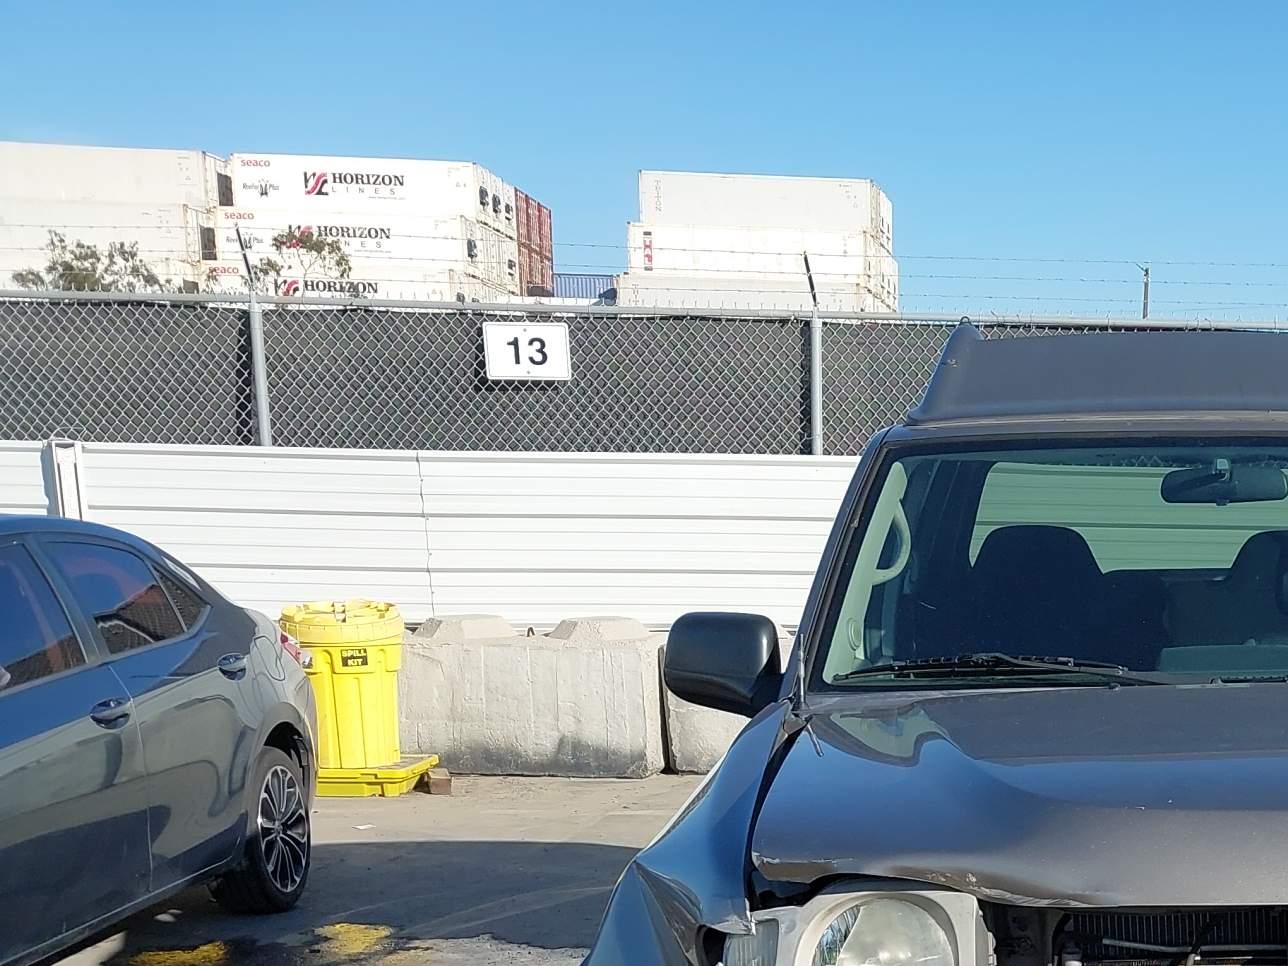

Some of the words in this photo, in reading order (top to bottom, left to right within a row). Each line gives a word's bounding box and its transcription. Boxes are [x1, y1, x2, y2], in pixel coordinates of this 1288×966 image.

[240, 158, 271, 168] seaco
[331, 172, 405, 187] HORIZON
[331, 186, 396, 196] LINES
[224, 212, 255, 220] seaco
[316, 225, 391, 240] HORIZON
[208, 264, 239, 274] seaco
[304, 279, 379, 294] HORIZON
[506, 336, 548, 366] 13
[342, 650, 367, 658] SPILL
[347, 658, 363, 666] KIT
